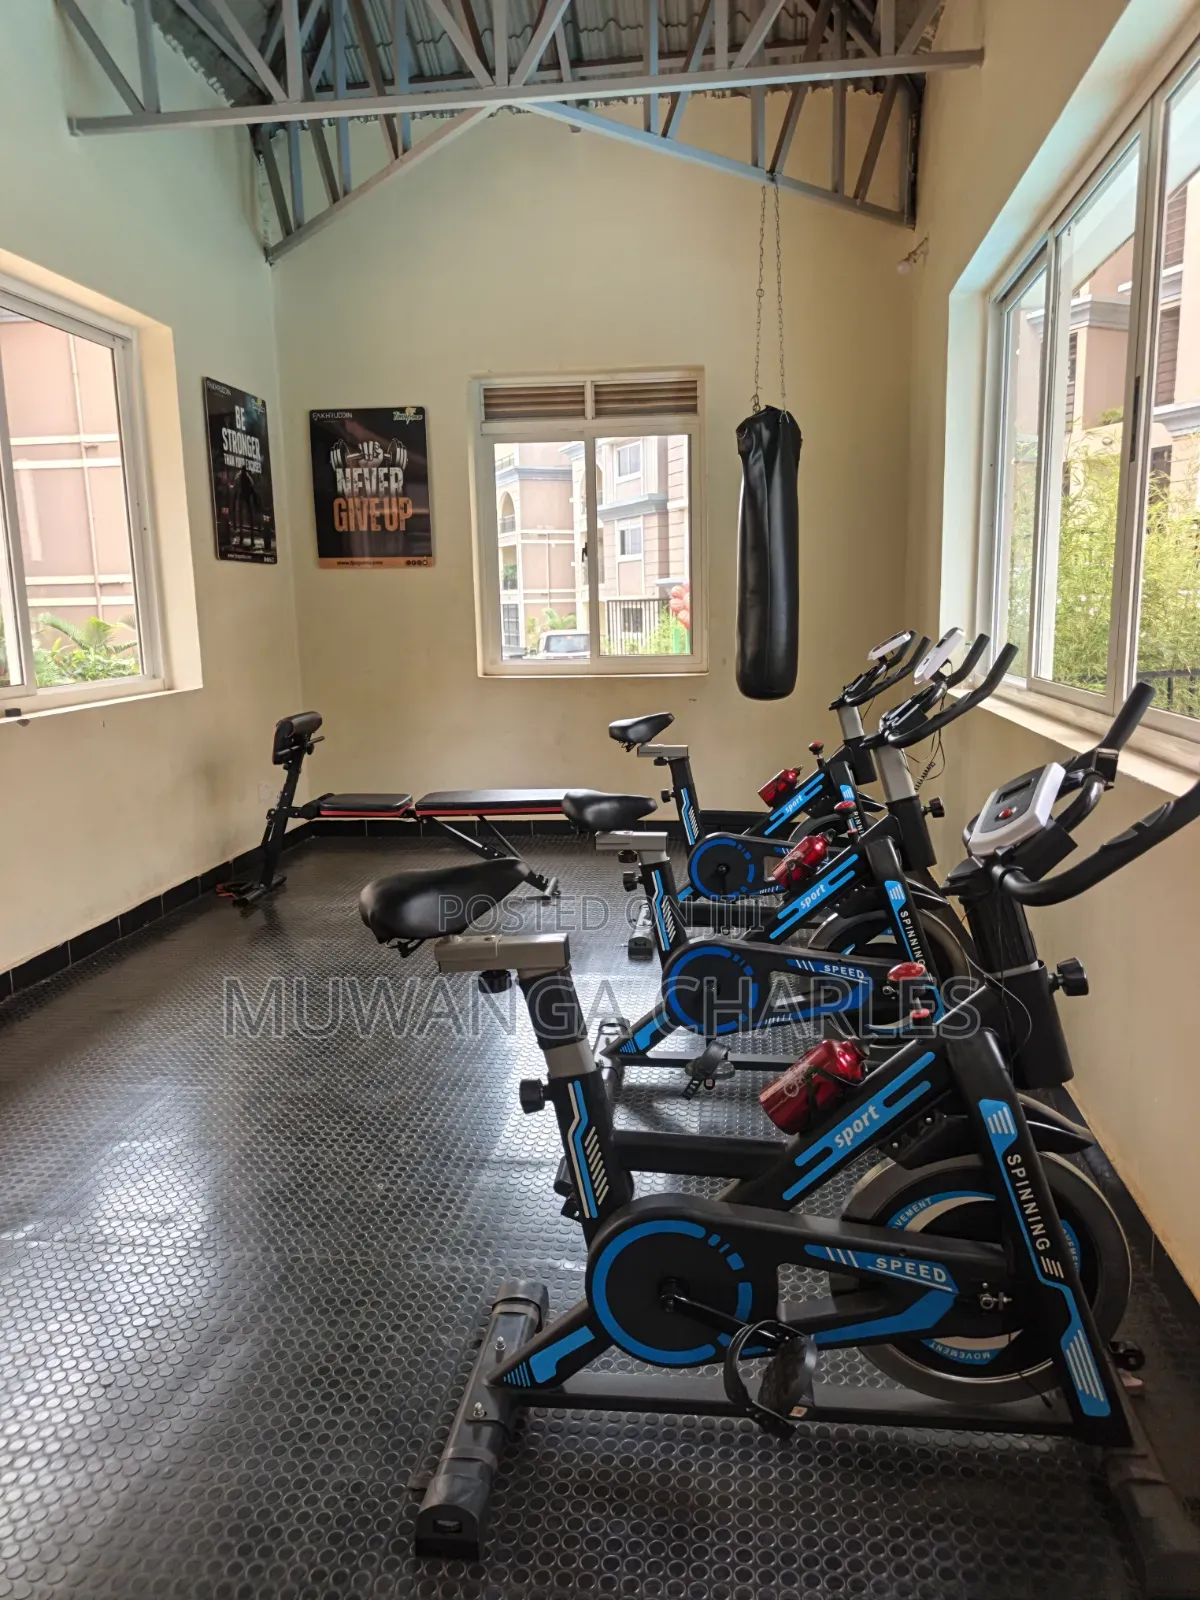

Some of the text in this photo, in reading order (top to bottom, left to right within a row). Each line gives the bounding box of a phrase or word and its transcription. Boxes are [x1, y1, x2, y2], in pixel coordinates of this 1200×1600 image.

[235, 405, 246, 431] BE
[221, 427, 261, 460] STRONGER
[336, 467, 404, 496] NEVER
[785, 795, 804, 814] sport
[800, 884, 827, 909] sport
[824, 964, 865, 980] SPEED
[834, 1104, 880, 1148] sport
[892, 1197, 931, 1229] VEMENT
[1006, 1153, 1051, 1251] SPINNING
[876, 1258, 947, 1283] SPEED
[930, 1341, 991, 1360] MOVEMENT
